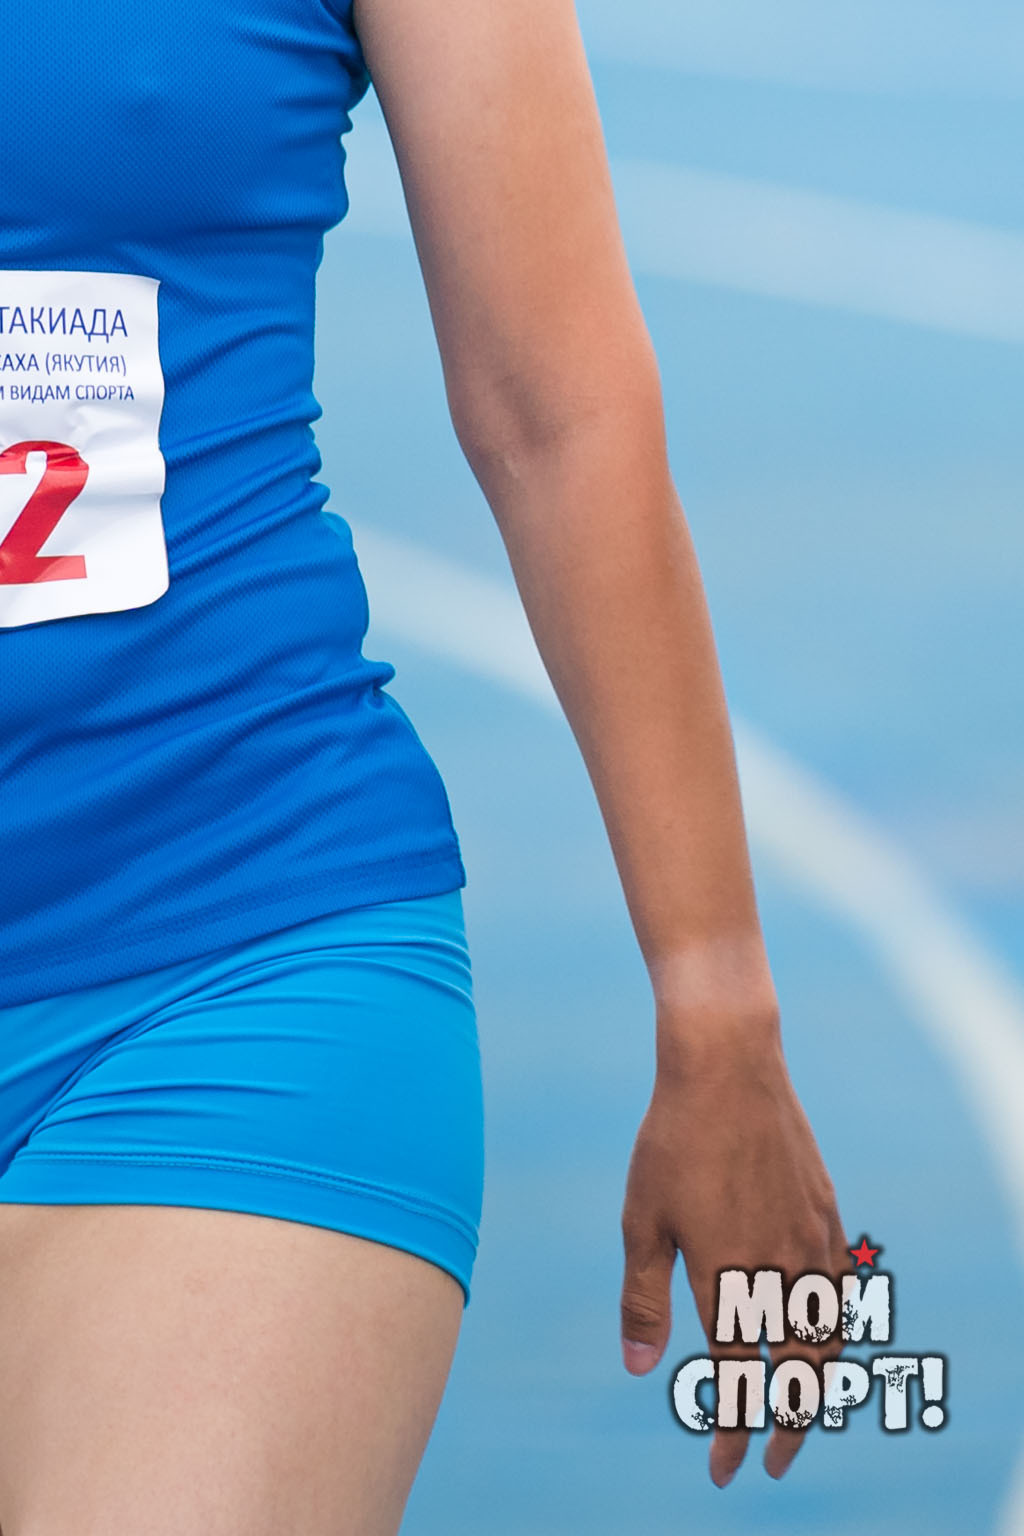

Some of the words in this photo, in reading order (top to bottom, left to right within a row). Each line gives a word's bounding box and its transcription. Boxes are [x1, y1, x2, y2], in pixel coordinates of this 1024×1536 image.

[45, 352, 127, 376] (ЯКУТИЯ)
[10, 384, 70, 404] ВИДАМ
[75, 384, 135, 401] СПОРТА
